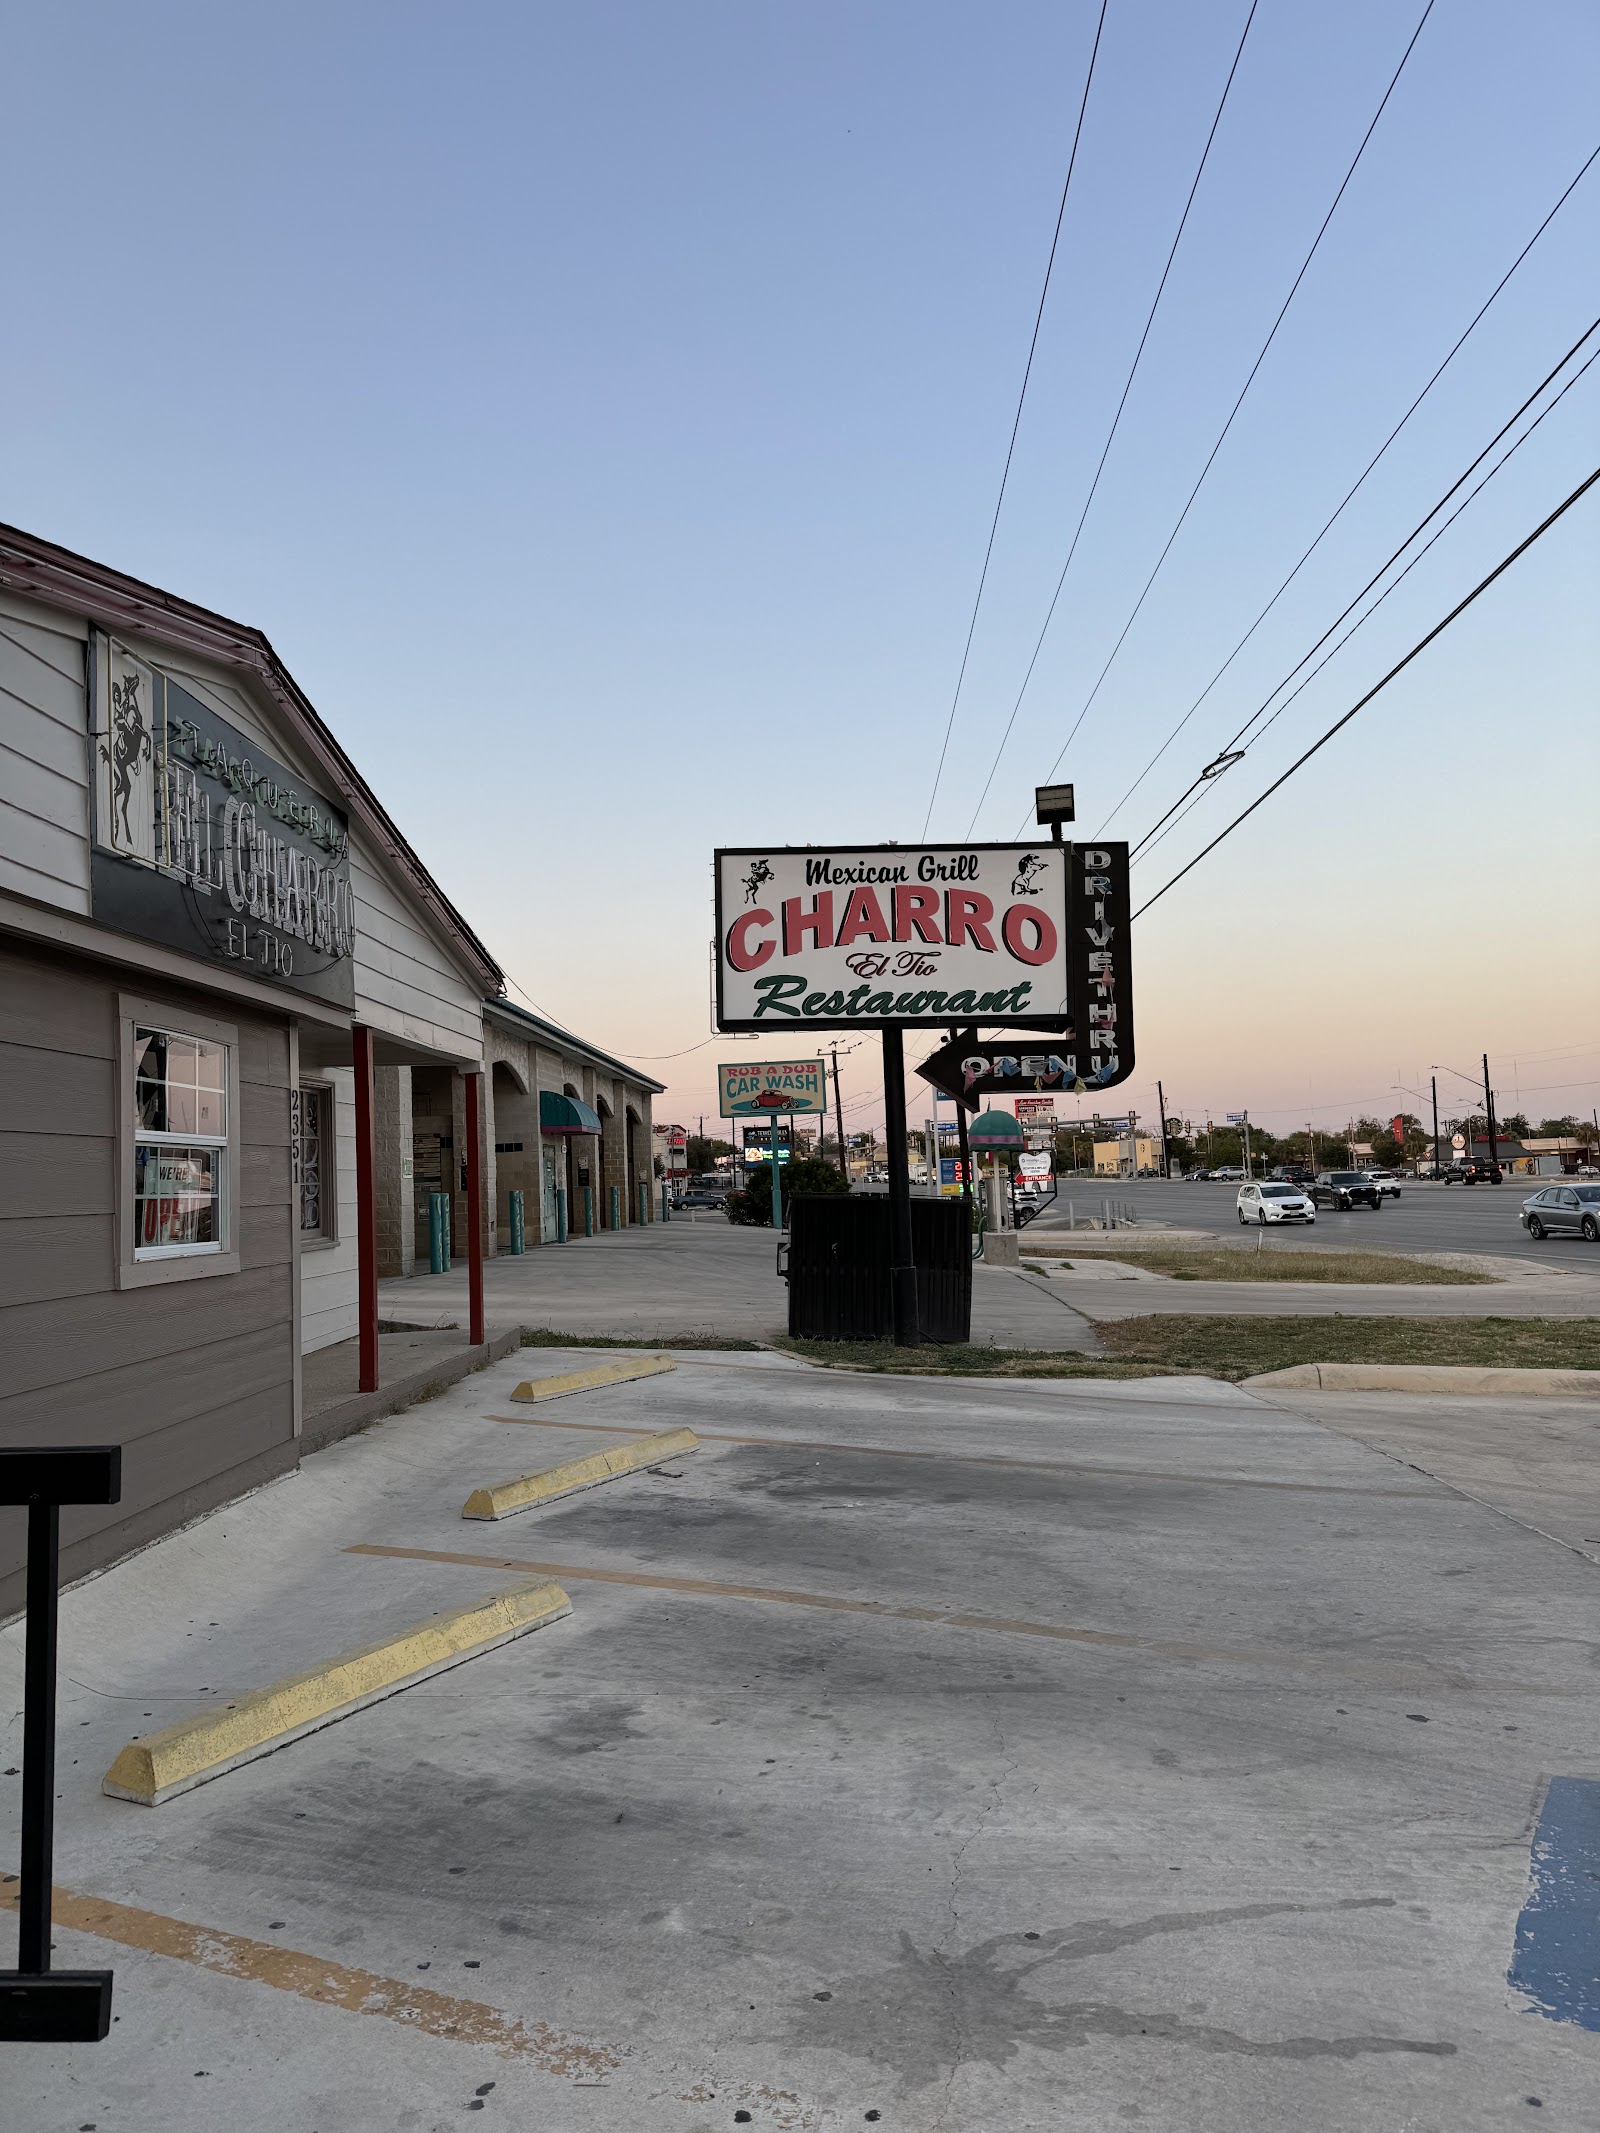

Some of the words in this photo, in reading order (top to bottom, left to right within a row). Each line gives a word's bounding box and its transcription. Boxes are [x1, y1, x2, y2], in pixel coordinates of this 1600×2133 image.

[223, 795, 355, 957] CHARRO
[806, 858, 909, 886] Mexican
[917, 855, 980, 882] Grill
[726, 884, 1058, 973] CHARRO
[845, 951, 887, 979] El
[891, 950, 942, 977] Tio
[752, 975, 1033, 1018] Restaurant
[726, 1066, 762, 1078] RUB
[766, 1066, 778, 1075] A
[782, 1064, 817, 1075] DUB
[961, 1055, 1077, 1078] OPEN
[726, 1077, 760, 1099] CAR
[765, 1074, 819, 1093] WASH
[291, 1089, 300, 1184] 2351
[159, 1166, 188, 1181] WE'RE
[144, 1196, 196, 1243] OPEN
